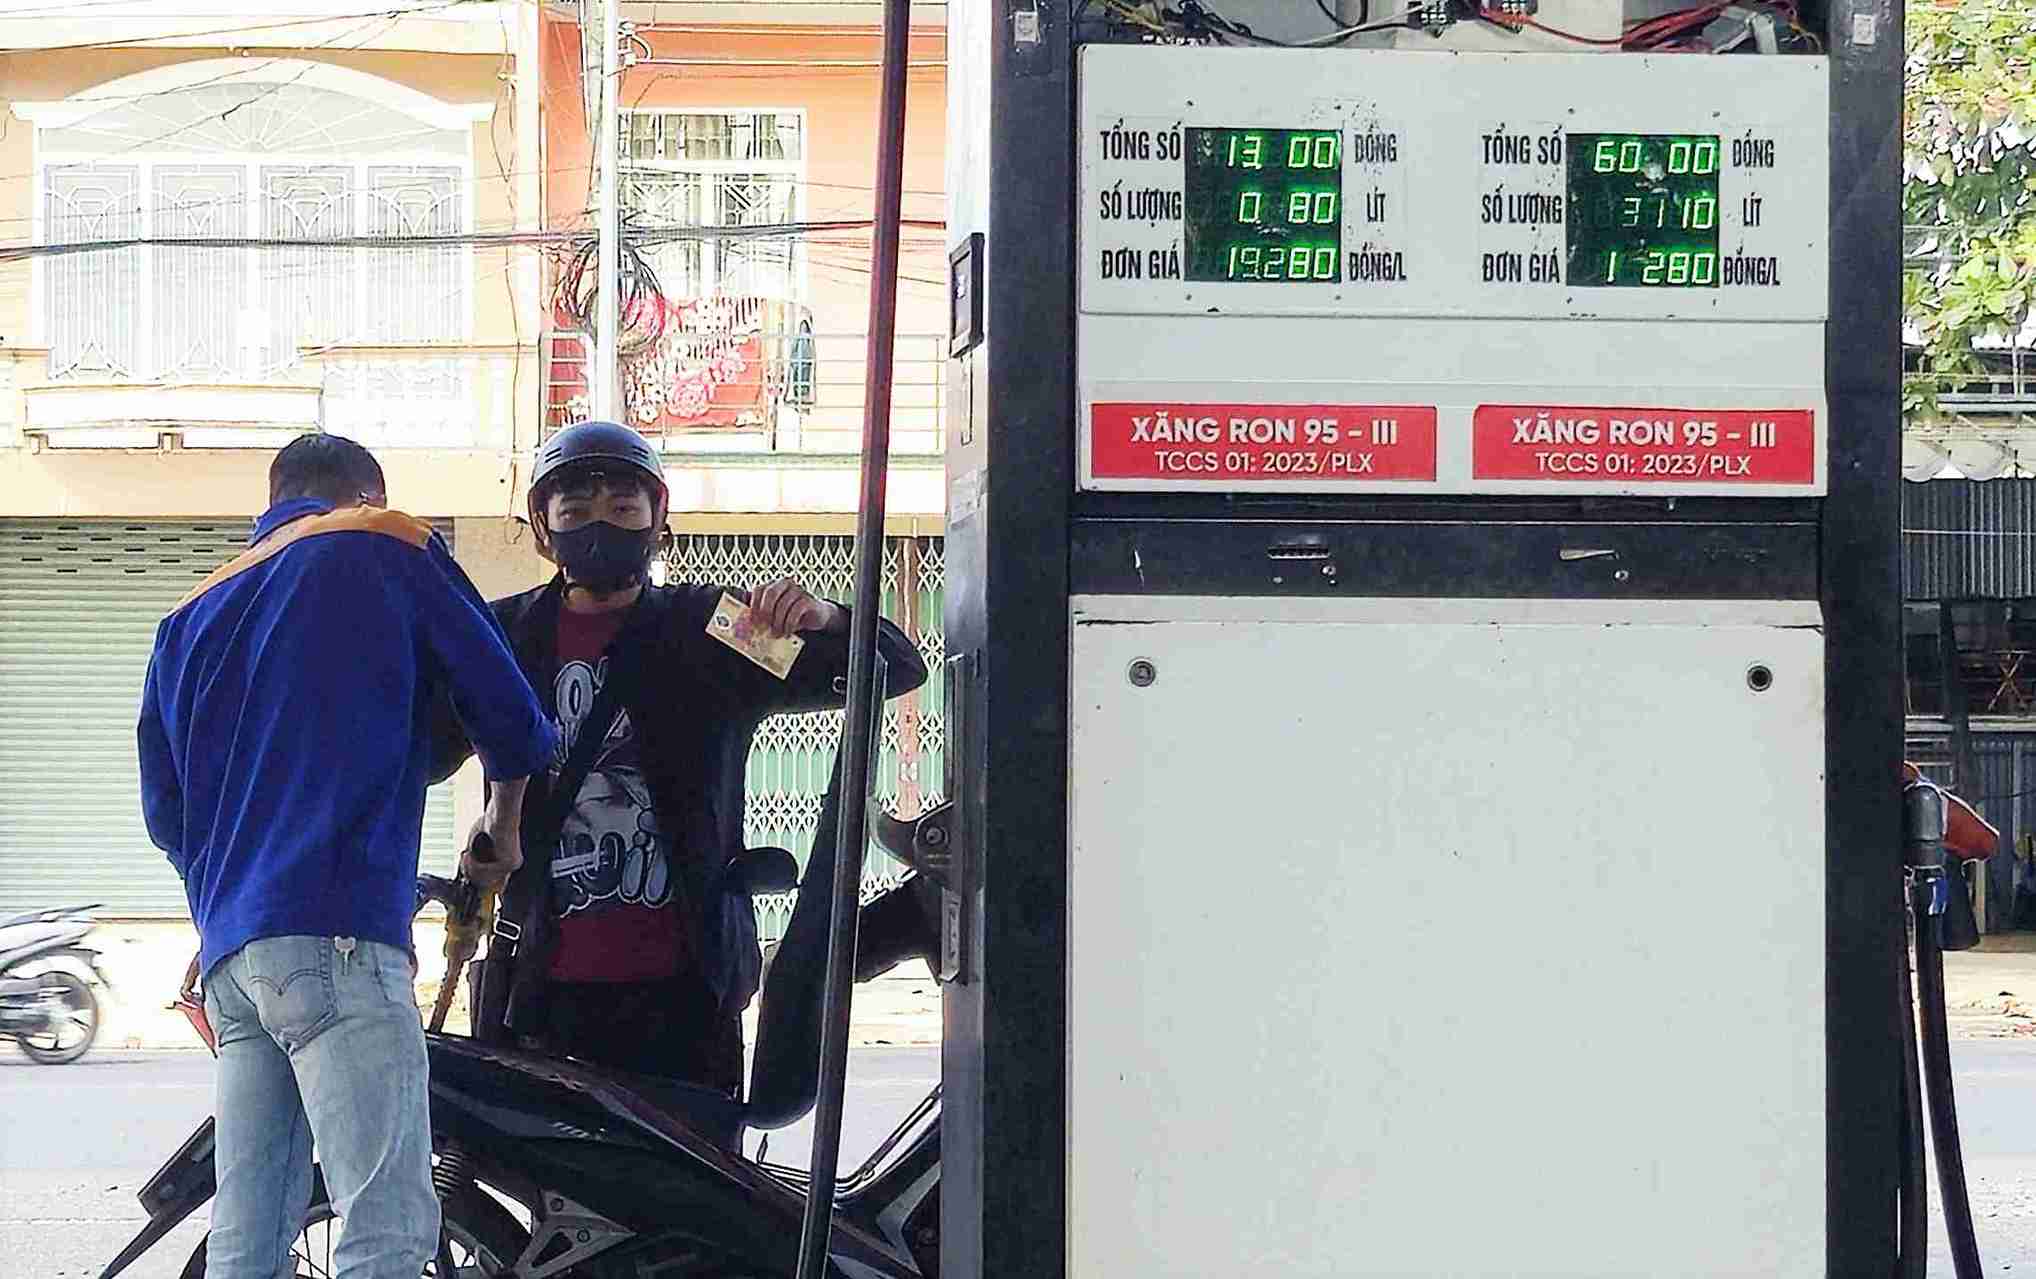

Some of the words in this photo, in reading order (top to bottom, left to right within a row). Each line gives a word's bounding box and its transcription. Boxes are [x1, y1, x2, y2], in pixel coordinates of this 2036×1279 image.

[1100, 118, 1149, 160] TỔNG
[1156, 121, 1181, 160] SỐ
[1482, 122, 1530, 164] TỔNG
[1537, 125, 1562, 164] SỐ
[1100, 179, 1122, 220] SỐ
[1127, 188, 1182, 227] LƯỢNG
[1367, 186, 1386, 223] LÍT
[1482, 184, 1503, 224] SỐ
[1508, 192, 1562, 231] LƯỢNG
[1743, 192, 1762, 227] LÍT
[1101, 247, 1141, 279] ĐƠN
[1149, 241, 1180, 279] GIÁ
[1482, 251, 1521, 282] ĐƠN
[1529, 247, 1560, 283] GIÁ
[1130, 411, 1220, 443] XĂNG
[1230, 418, 1296, 444] RON
[1304, 418, 1339, 444] 95
[1372, 419, 1398, 445] III
[1512, 411, 1600, 445] XĂNG
[1608, 419, 1674, 446] RON
[1683, 421, 1718, 447] 95
[1750, 421, 1776, 448] III
[1154, 450, 1219, 472] TCCS
[1225, 451, 1256, 472] 01:
[1262, 450, 1373, 474] 2023/PLX
[1535, 452, 1599, 473] TCCS
[1605, 453, 1635, 474] 01:
[1641, 452, 1752, 477] 2023/PLX
